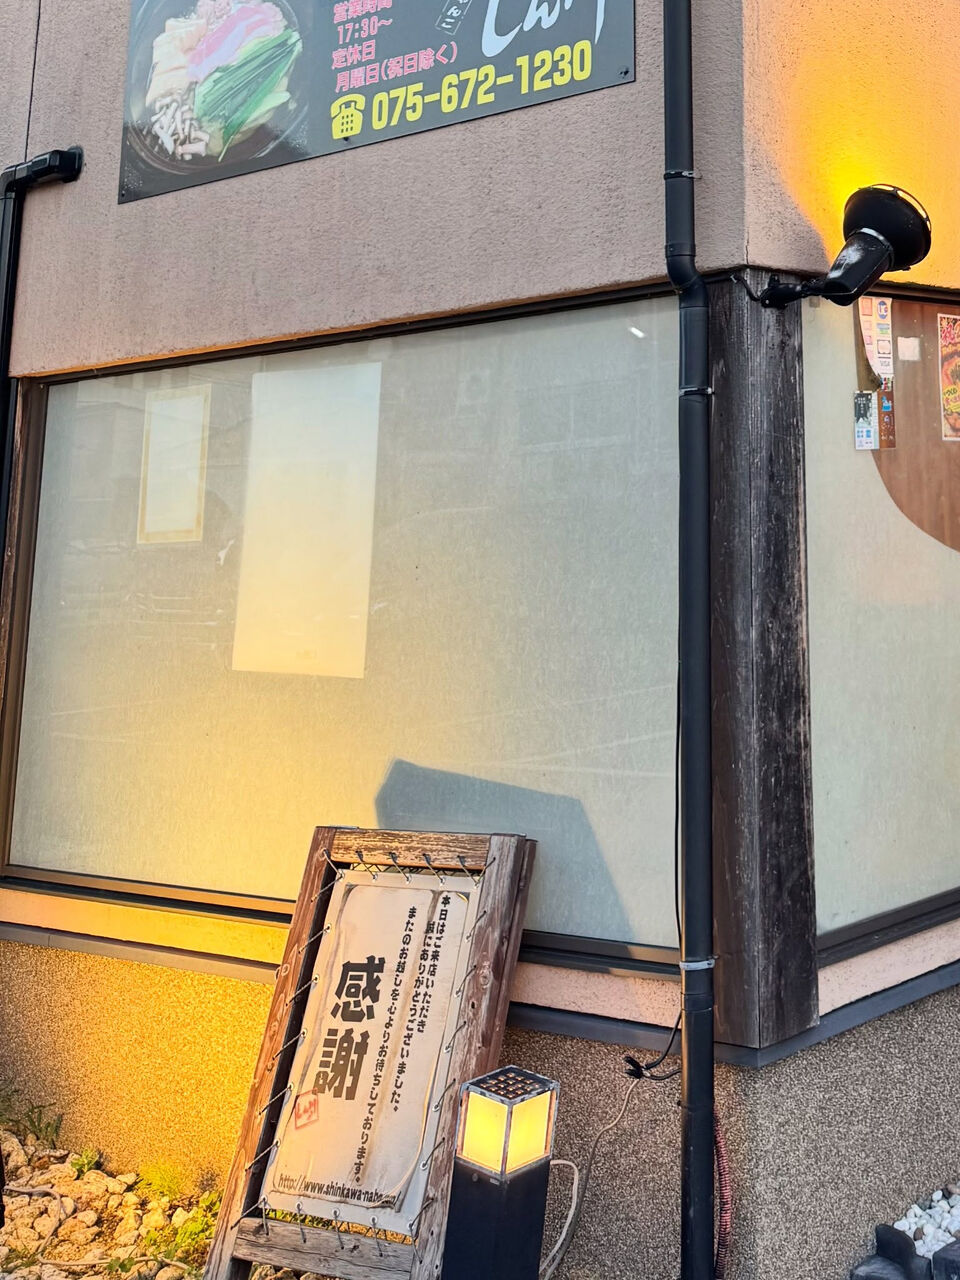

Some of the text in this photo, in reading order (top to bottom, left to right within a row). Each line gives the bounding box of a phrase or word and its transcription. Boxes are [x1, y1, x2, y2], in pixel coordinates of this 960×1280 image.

[331, 39, 376, 69] 定休日
[372, 40, 592, 130] 075-672-1230
[417, 894, 451, 1033] 本日はご来店いただき
[312, 955, 385, 1100] 感謝
